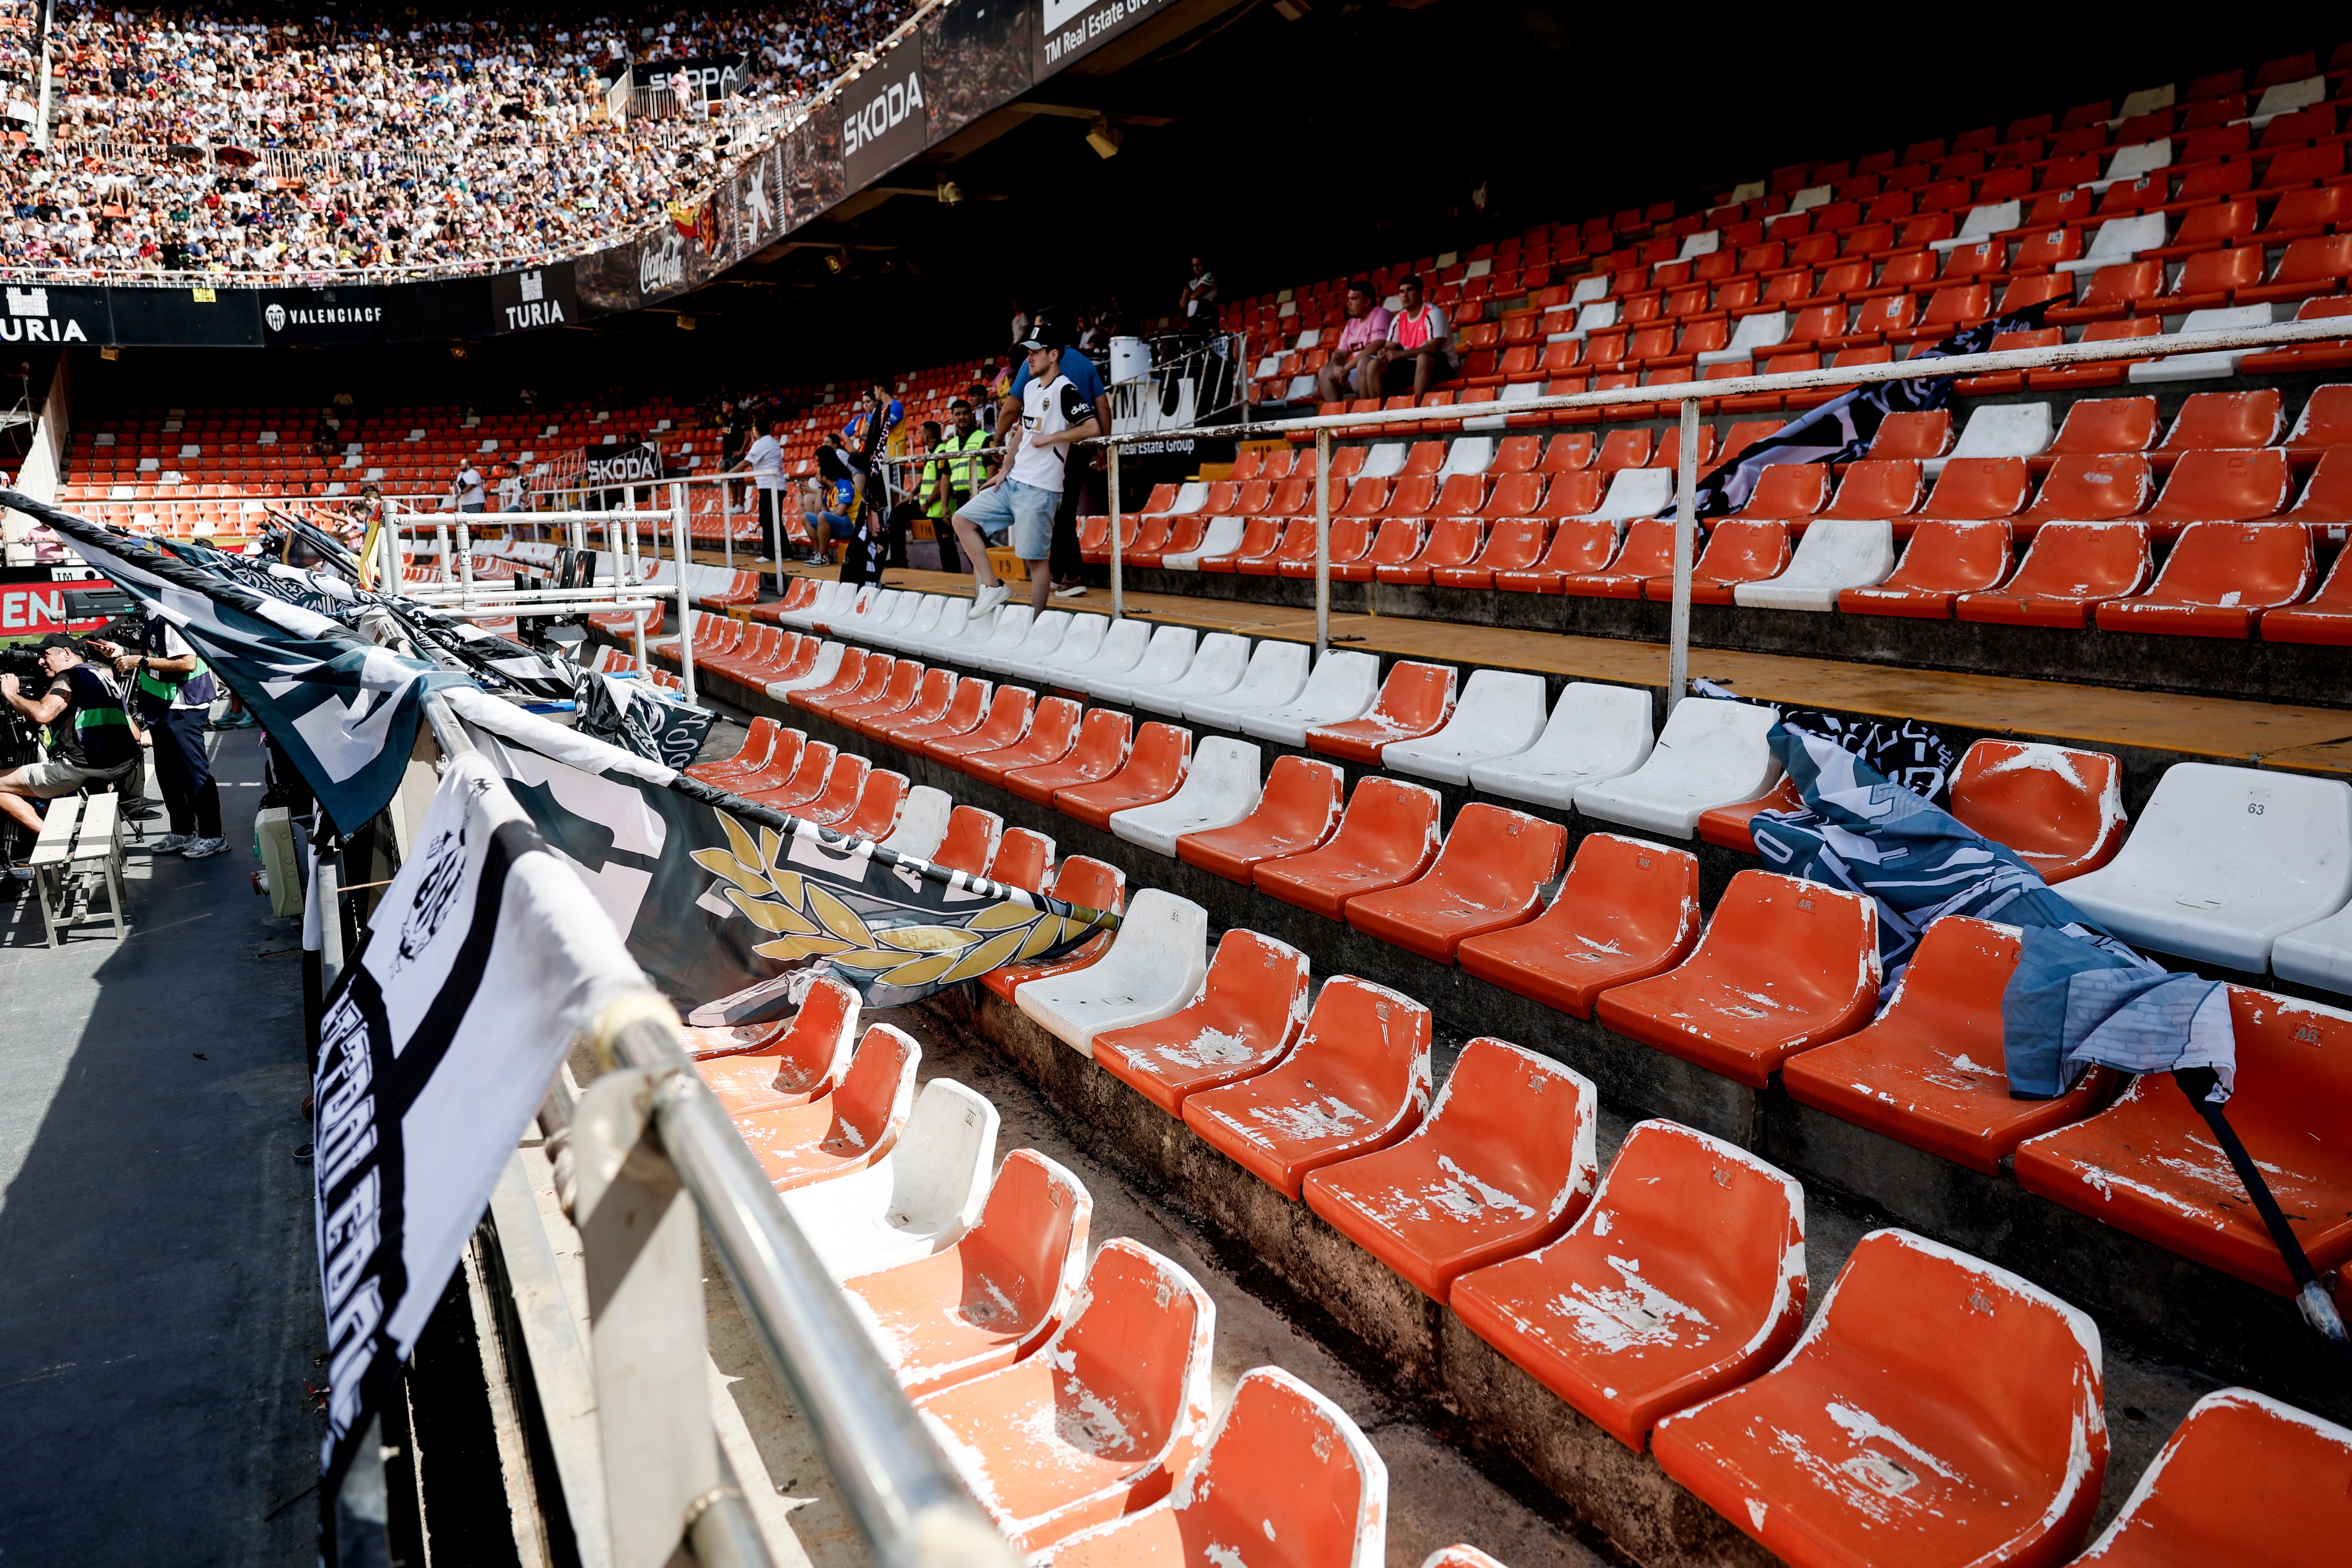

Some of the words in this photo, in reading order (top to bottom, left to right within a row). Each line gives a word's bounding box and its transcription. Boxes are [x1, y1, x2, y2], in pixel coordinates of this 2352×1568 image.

[1044, 37, 1061, 65] TM
[1063, 19, 1086, 54] Real
[1089, 1, 1124, 39] Estate
[506, 300, 564, 329] TURIA
[1138, 441, 1164, 453] Estate
[1166, 438, 1195, 455] Group
[2248, 803, 2265, 815] 63
[1639, 857, 1650, 868] 49
[1798, 899, 1812, 911] 48
[2013, 950, 2021, 962] 4
[966, 1112, 974, 1124] 50
[1713, 1169, 1731, 1185] 47
[1969, 1291, 1991, 1313] 46
